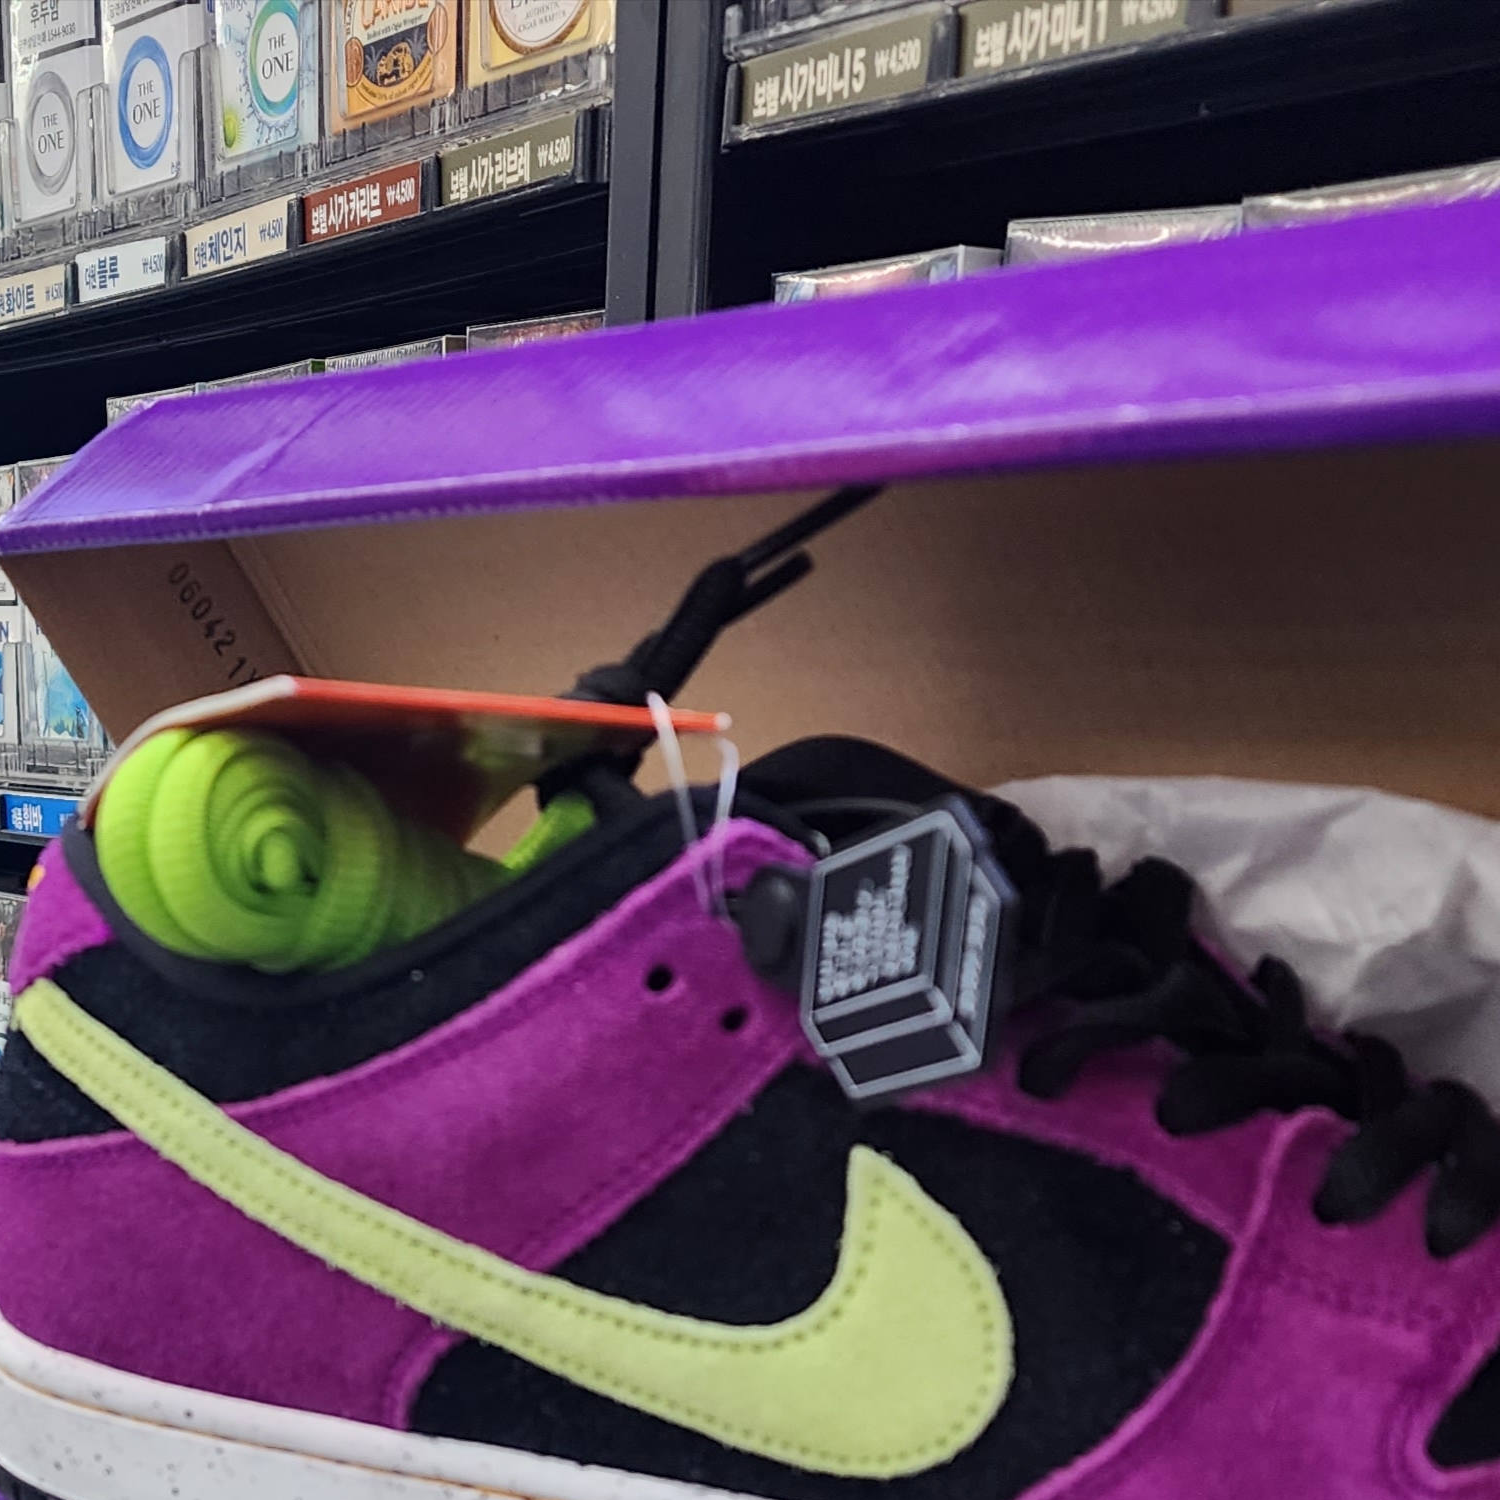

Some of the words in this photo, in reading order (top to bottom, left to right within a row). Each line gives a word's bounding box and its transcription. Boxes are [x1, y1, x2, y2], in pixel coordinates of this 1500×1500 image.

[30, 0, 59, 28] 후두암
[268, 33, 286, 51] THE
[973, 21, 1007, 68] 보헴
[262, 51, 294, 79] ONE
[752, 75, 780, 118] 보헴
[874, 38, 922, 79] ₩4,500
[138, 80, 154, 97] THE
[42, 113, 58, 129] THE
[133, 97, 160, 125] ONE
[38, 130, 65, 154] ONE
[450, 166, 469, 202] 보헴
[537, 135, 571, 168] ₩4,500
[311, 200, 328, 235] 보헴
[386, 177, 415, 207] ₩4,500
[193, 244, 208, 268] 더원
[208, 222, 248, 266] 체인지
[258, 217, 284, 243] ₩4,500
[84, 264, 97, 287] 더원
[97, 255, 119, 290] 블루
[141, 253, 164, 275] ₩4,500
[5, 283, 36, 315] 화이트
[169, 562, 257, 683] 060421
